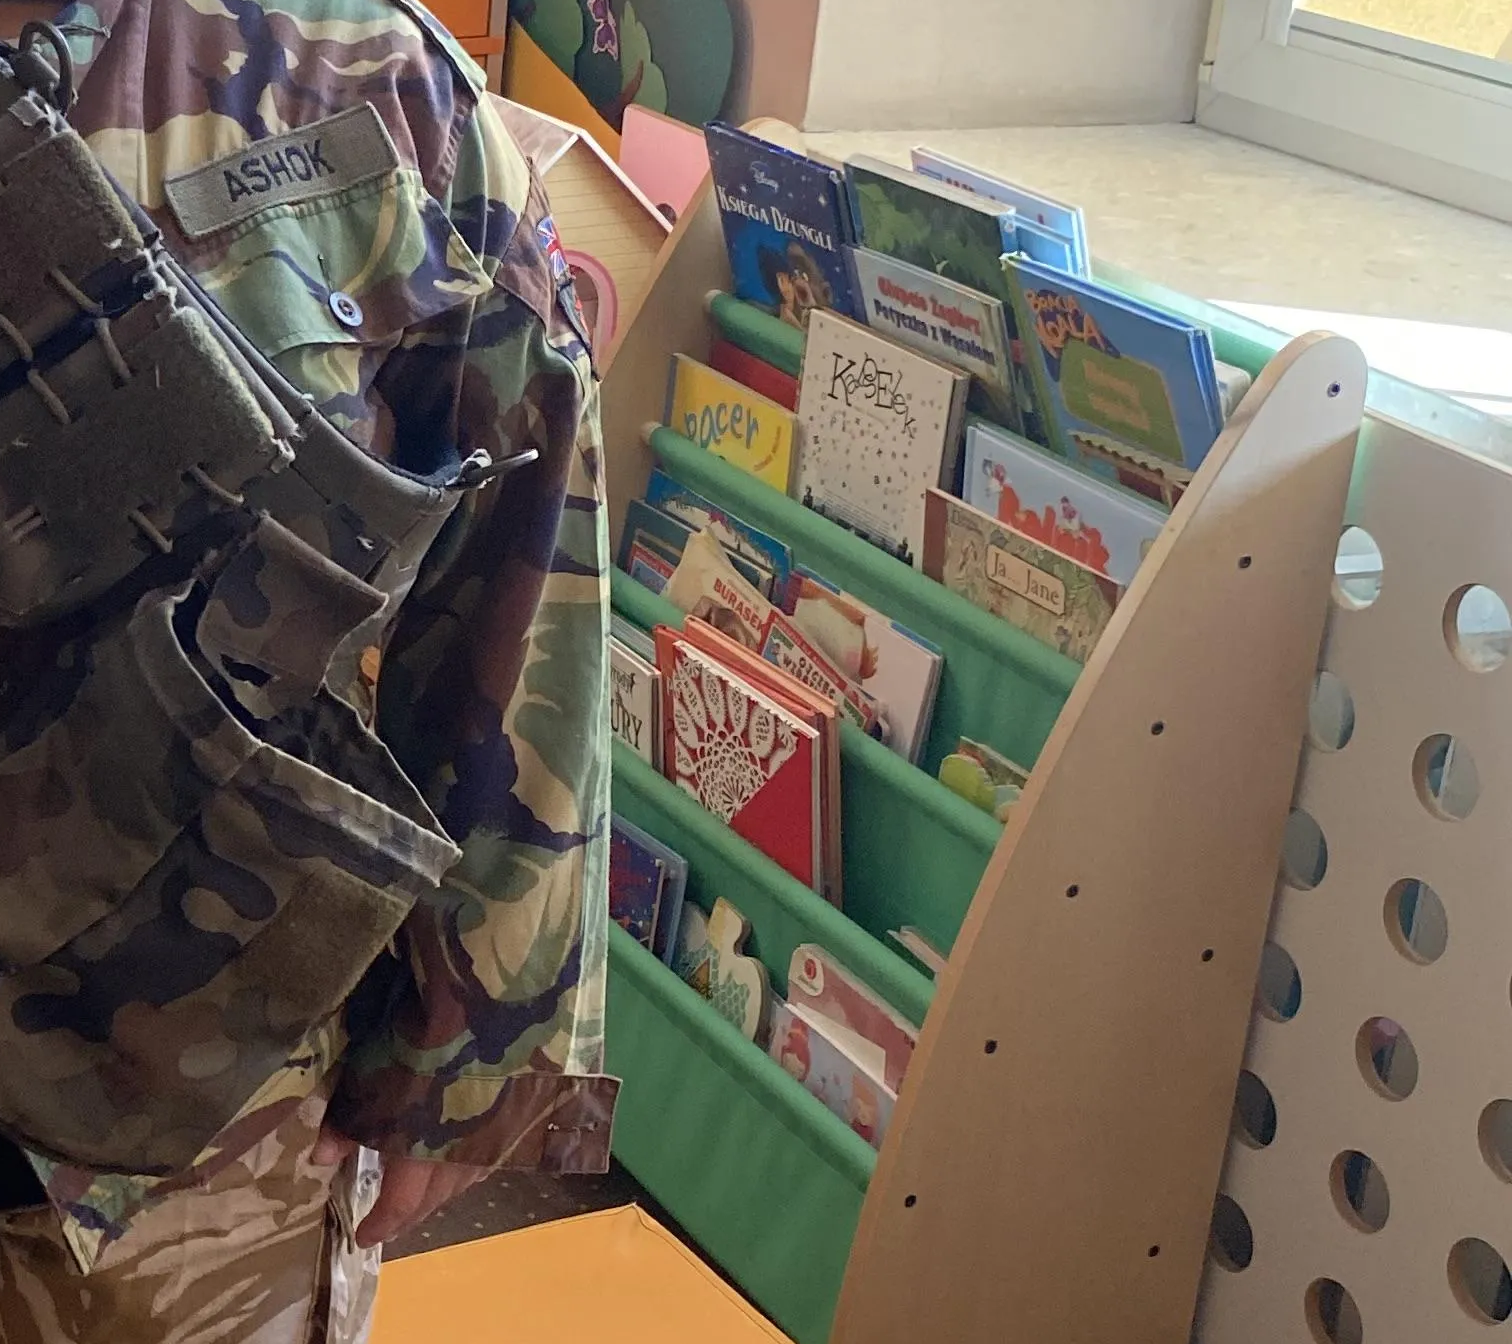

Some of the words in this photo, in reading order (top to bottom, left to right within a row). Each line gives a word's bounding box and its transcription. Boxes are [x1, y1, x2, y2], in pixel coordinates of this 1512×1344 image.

[223, 139, 336, 202] ASHOK
[1035, 313, 1107, 358] KOALA
[1024, 568, 1060, 606] Jane
[610, 697, 643, 751] URY
